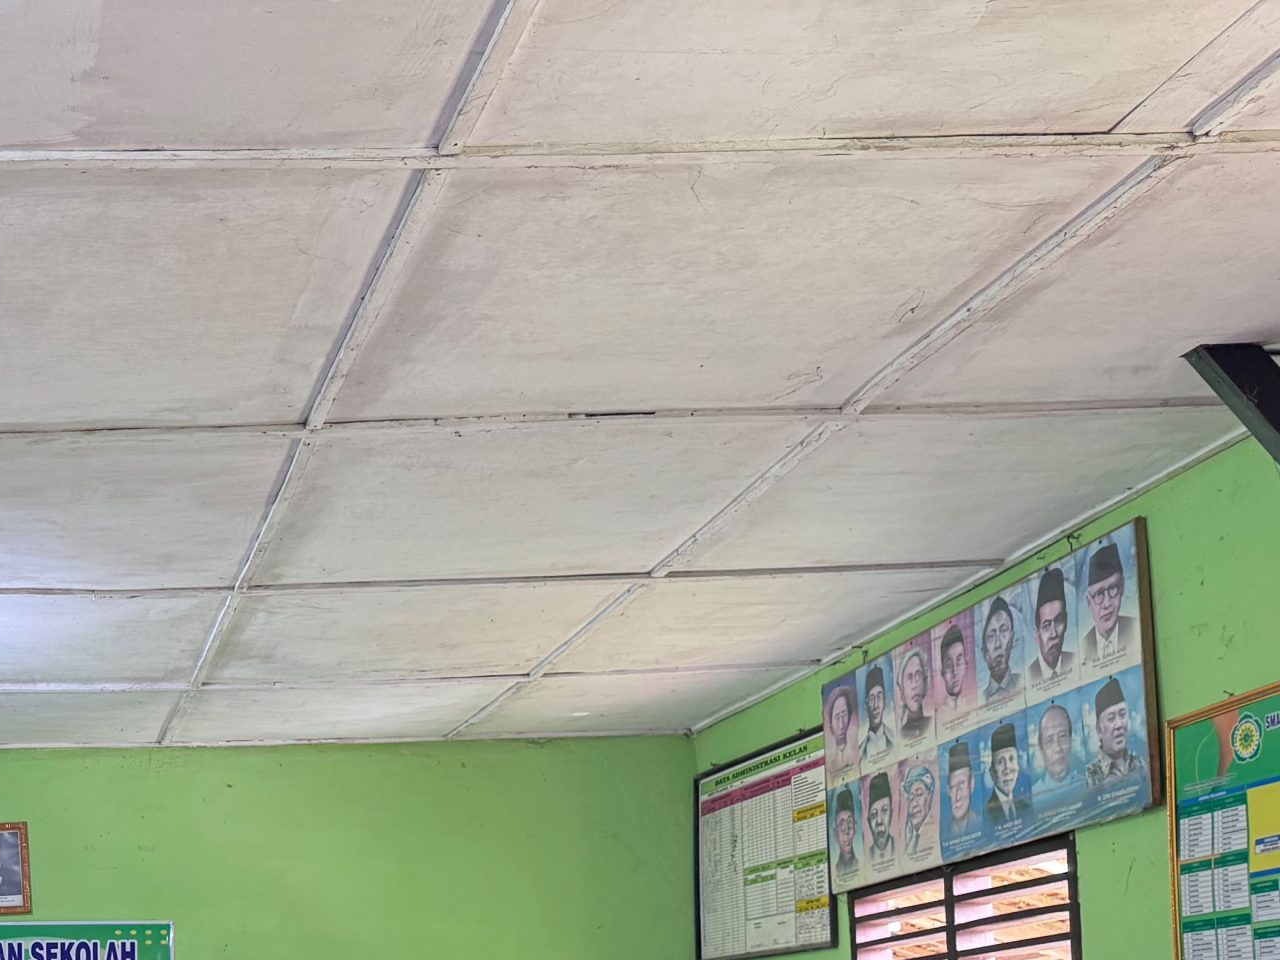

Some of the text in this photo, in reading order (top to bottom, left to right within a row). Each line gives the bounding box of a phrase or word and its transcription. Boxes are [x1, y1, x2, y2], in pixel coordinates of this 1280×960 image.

[714, 777, 730, 786] DATA
[731, 755, 781, 781] ADMINISTRASI
[782, 745, 808, 760] KELAS
